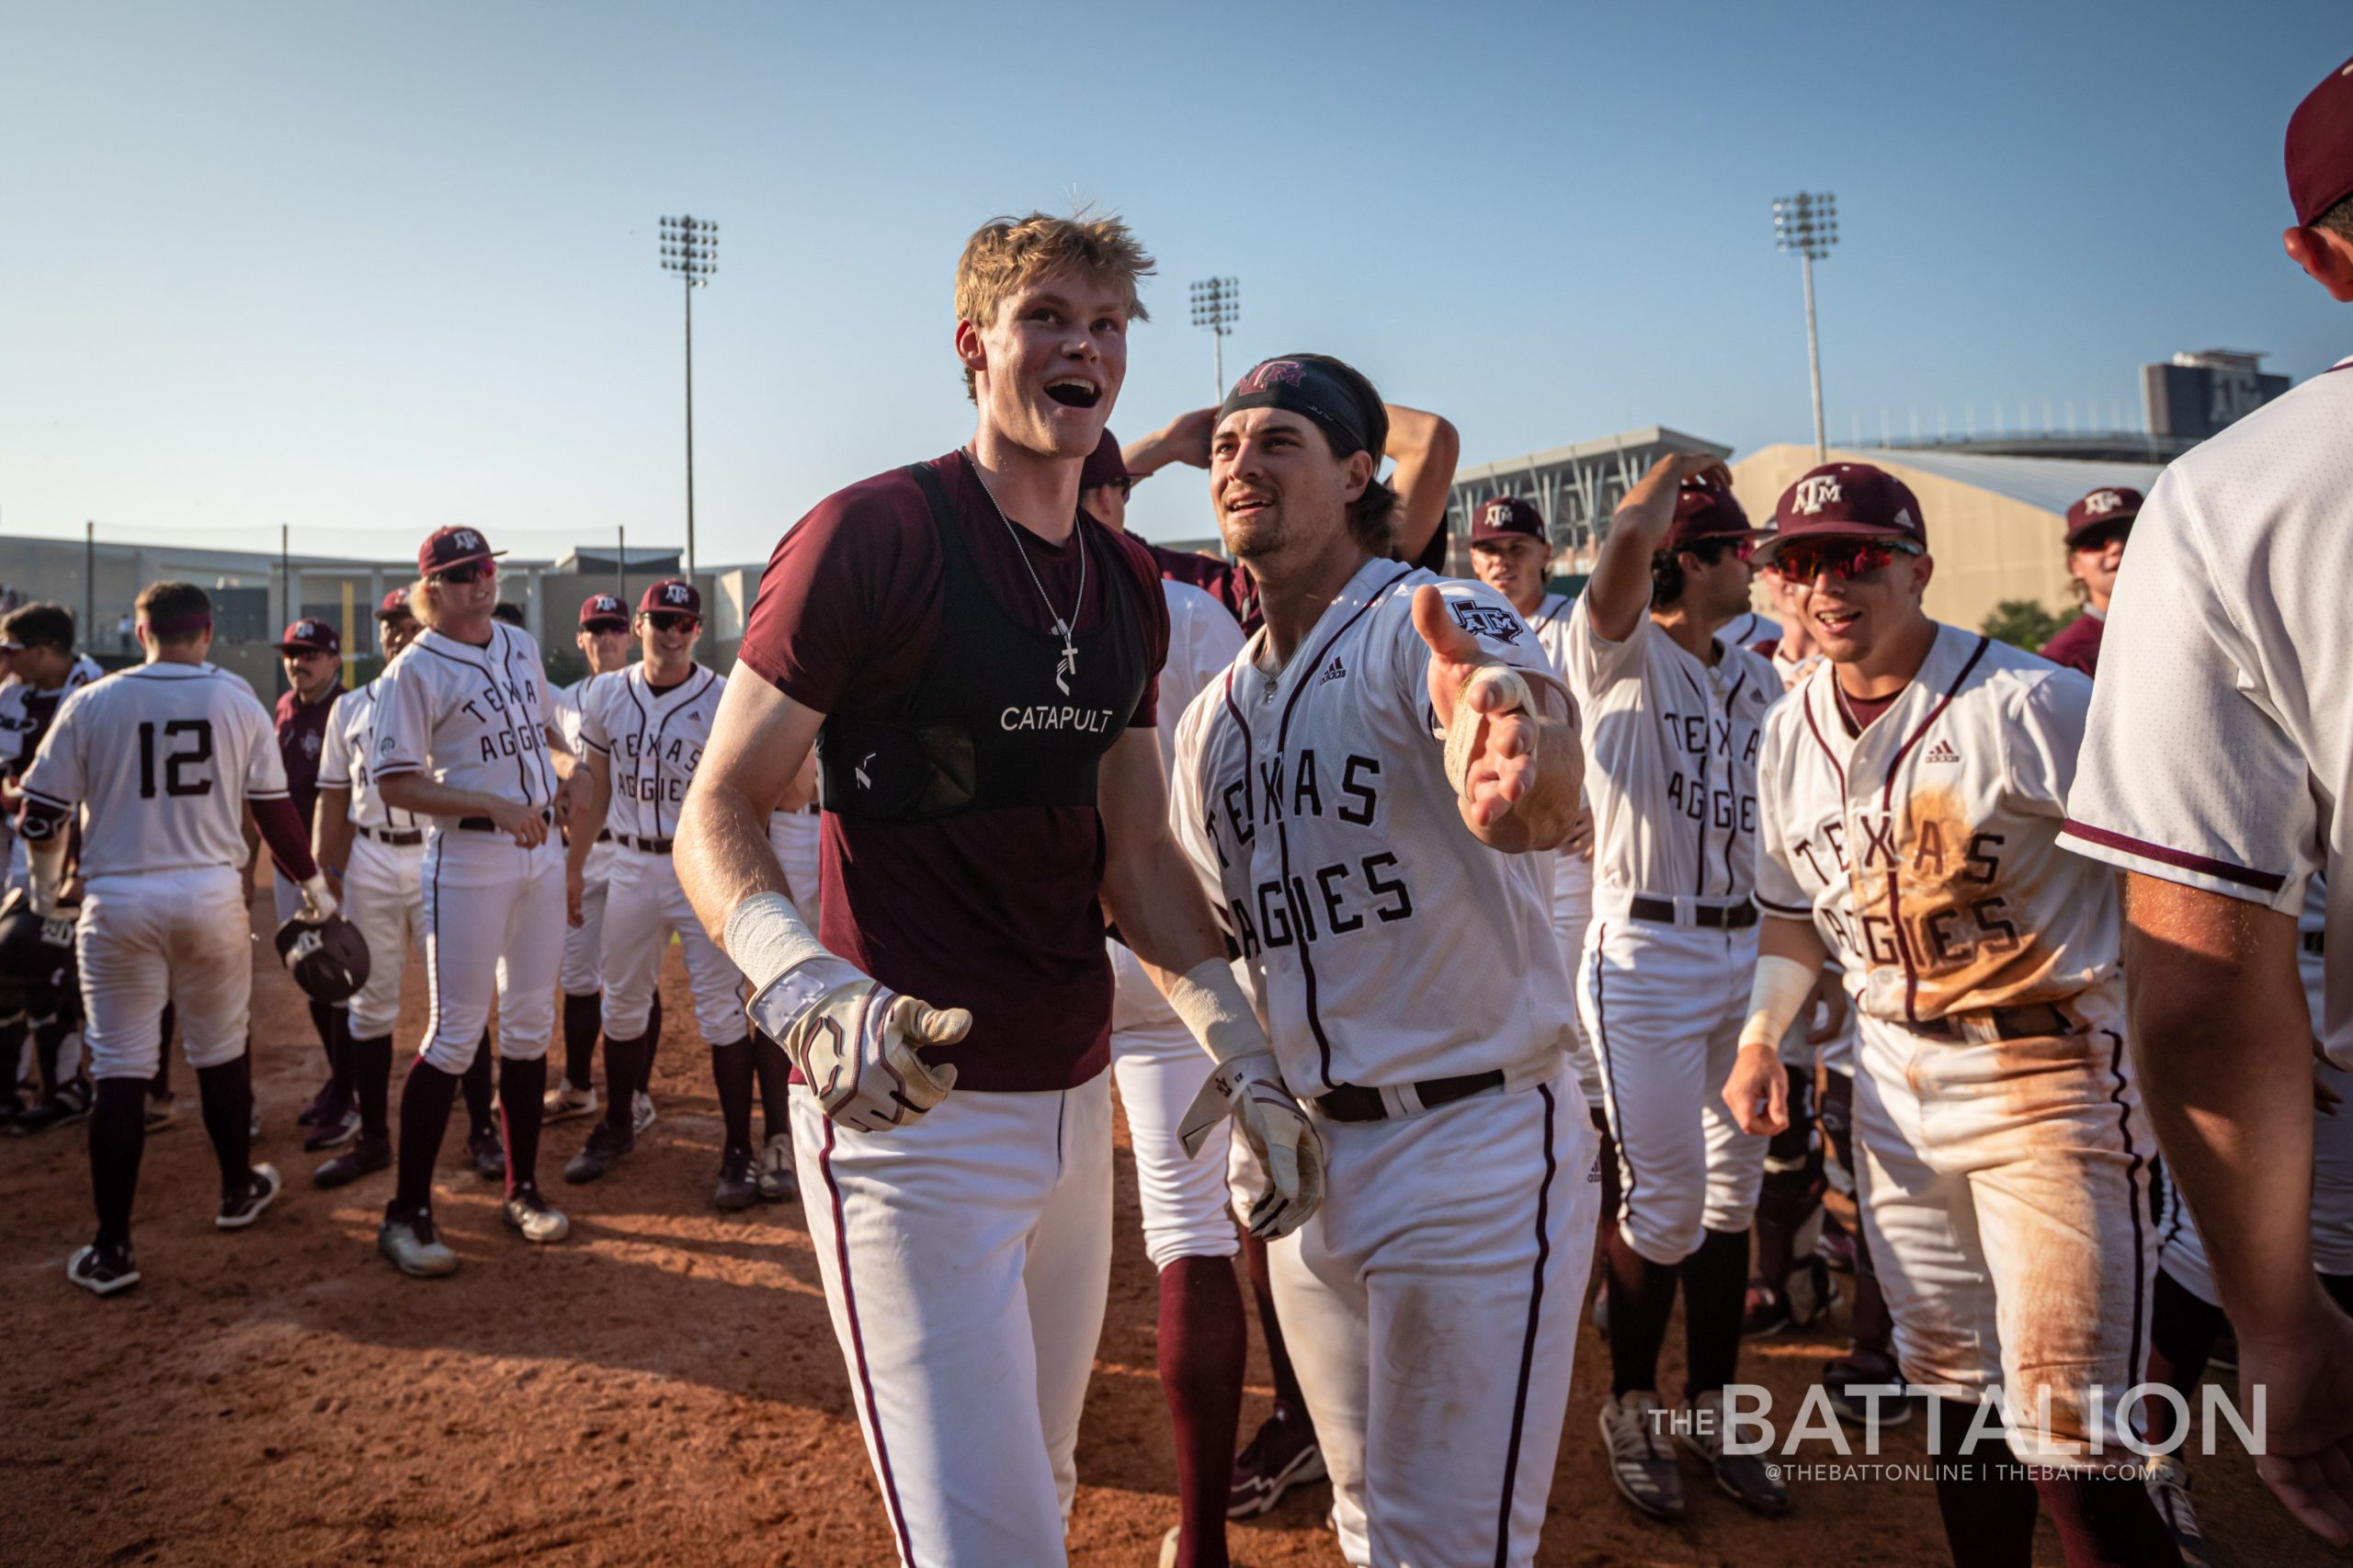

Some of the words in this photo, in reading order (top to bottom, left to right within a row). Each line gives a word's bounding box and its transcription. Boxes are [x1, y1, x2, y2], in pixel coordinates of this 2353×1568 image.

[1001, 706, 1113, 733] CATAPULT
[139, 720, 212, 800] 12
[618, 771, 690, 801] AGGIE
[1205, 749, 1381, 869] TEXAS
[1793, 815, 2005, 885] TEXAS
